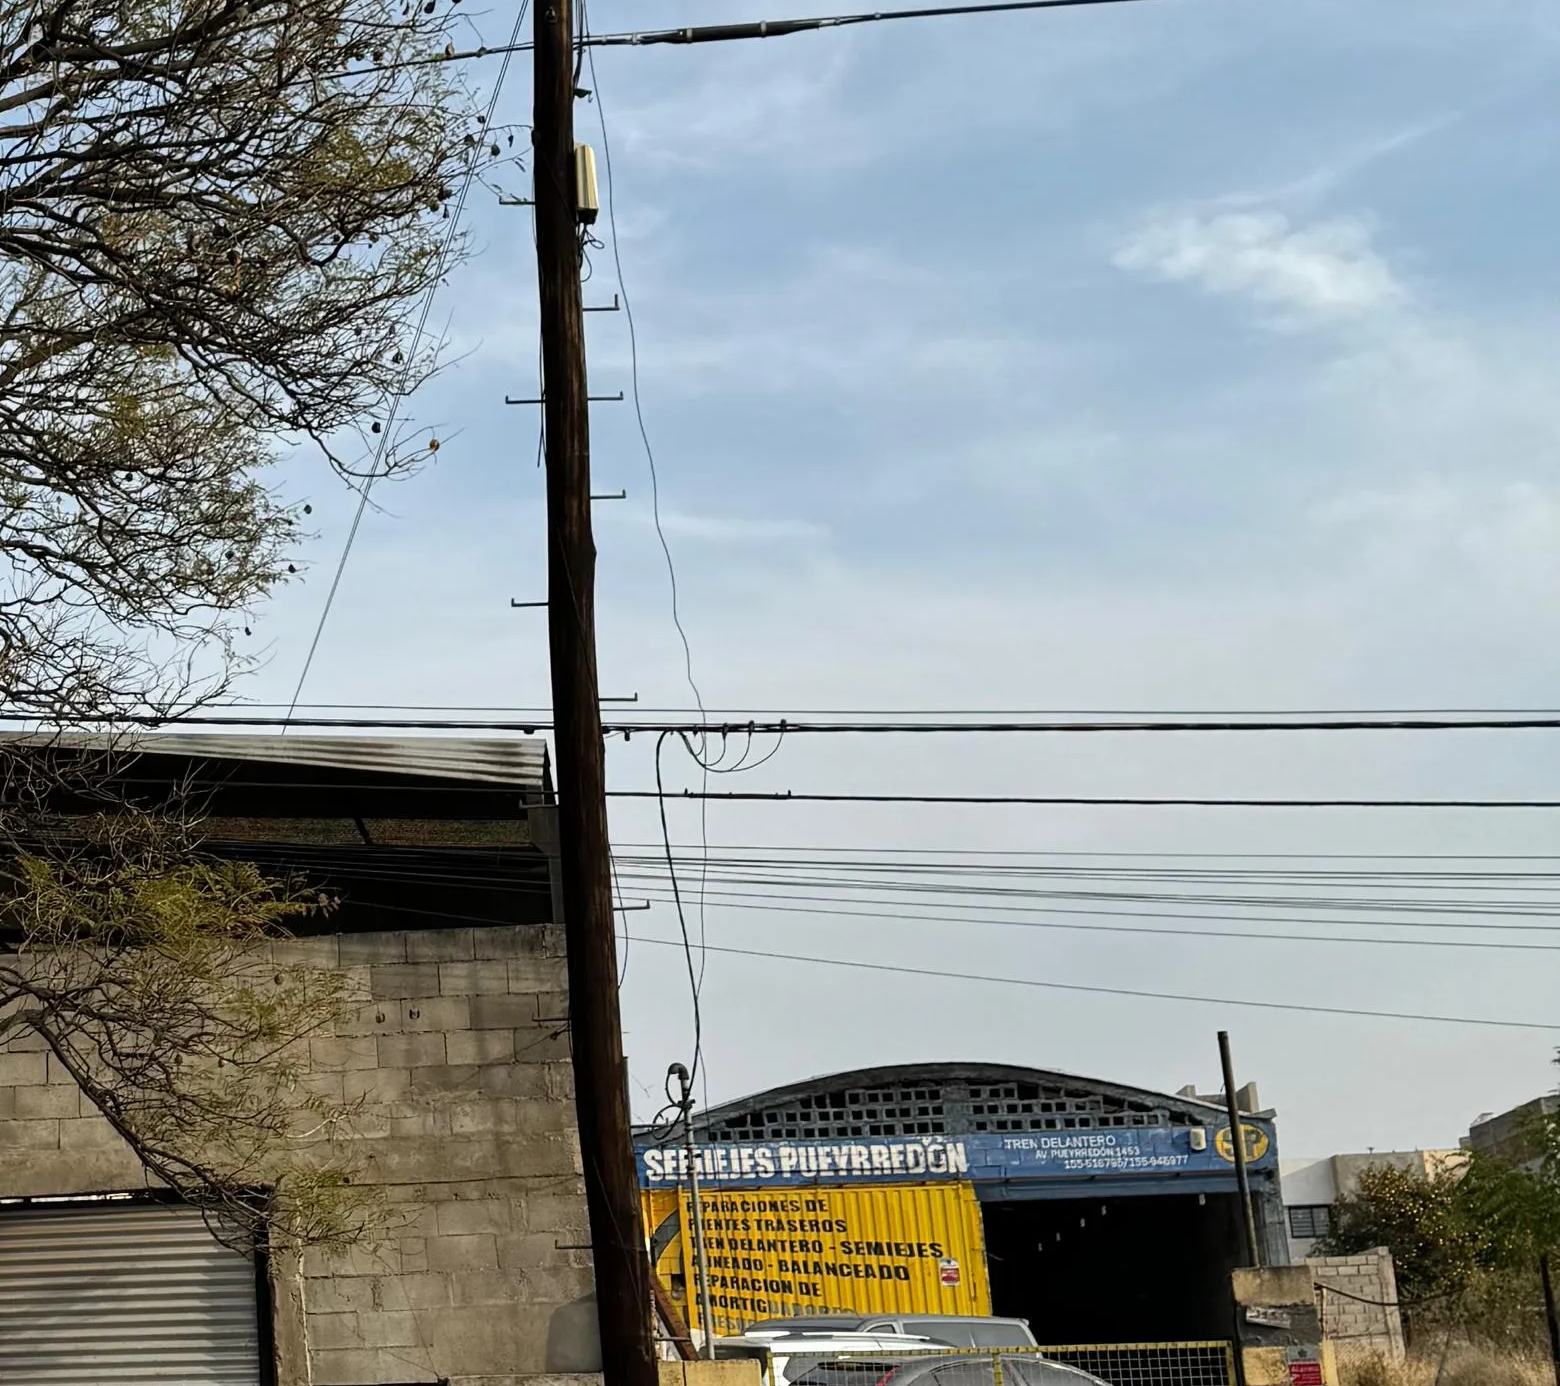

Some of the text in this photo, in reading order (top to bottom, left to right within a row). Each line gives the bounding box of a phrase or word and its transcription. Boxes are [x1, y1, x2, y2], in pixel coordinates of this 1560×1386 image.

[1041, 1135, 1116, 1149] DELANTERO
[805, 1199, 828, 1212] DE
[754, 1219, 848, 1233] TRASEROS
[728, 1238, 823, 1254] DELANTERO
[840, 1240, 944, 1258] SEMIEJES
[778, 1259, 911, 1281] BALANCEADO
[798, 1281, 822, 1297] DE
